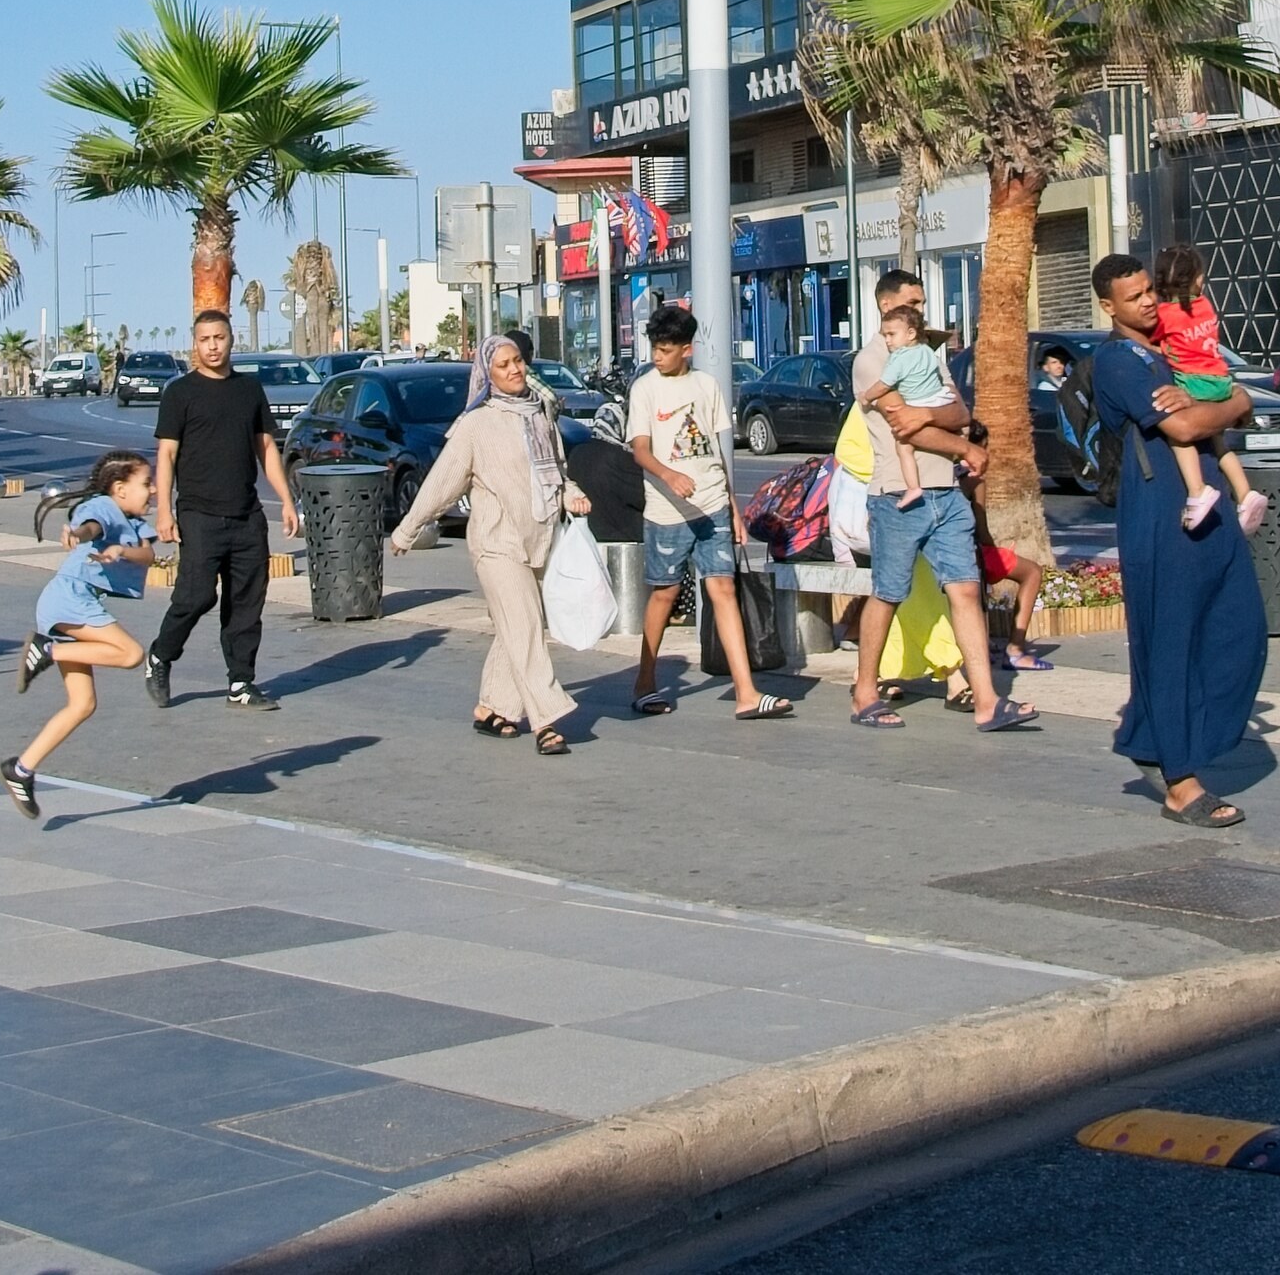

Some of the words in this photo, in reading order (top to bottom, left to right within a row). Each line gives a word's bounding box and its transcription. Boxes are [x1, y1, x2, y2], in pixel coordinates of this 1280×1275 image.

[526, 113, 553, 129] AZUR
[610, 96, 661, 140] AZUR
[525, 130, 555, 146] HOTEL
